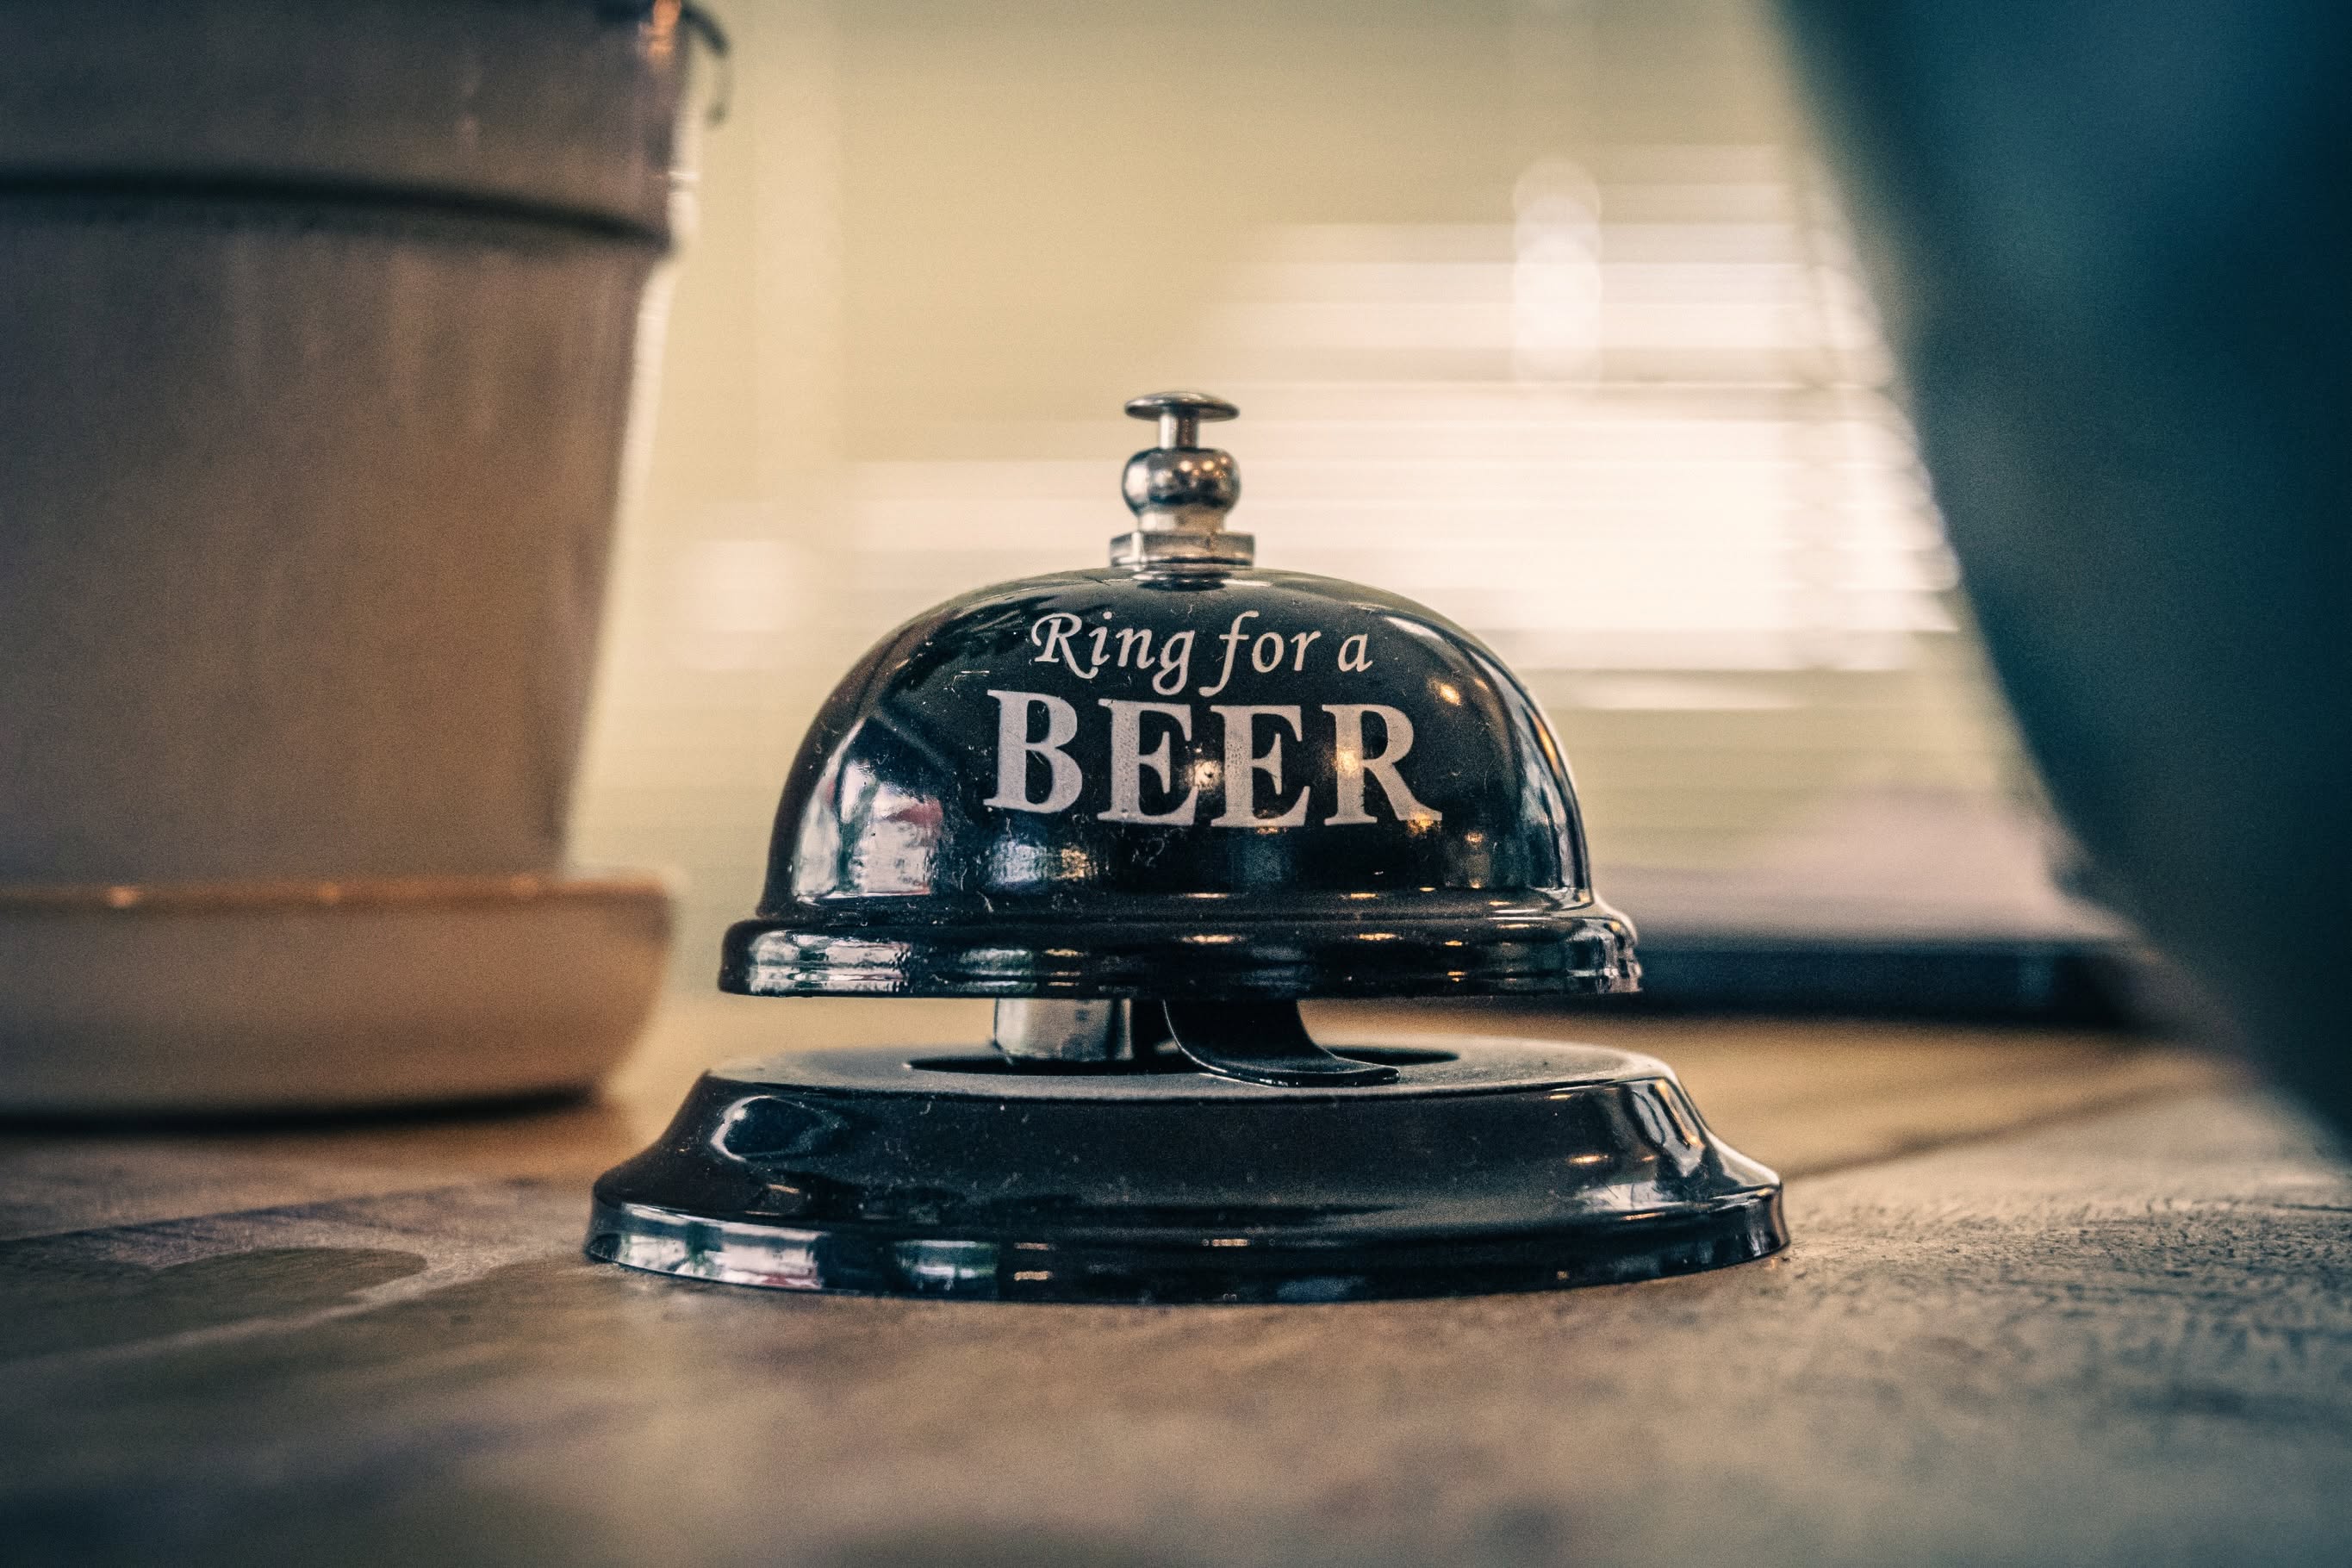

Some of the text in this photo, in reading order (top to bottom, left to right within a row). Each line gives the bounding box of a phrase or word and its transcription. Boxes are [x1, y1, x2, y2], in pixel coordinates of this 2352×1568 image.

[1030, 610, 1374, 697] Ring for a
[982, 688, 1443, 829] BEER
